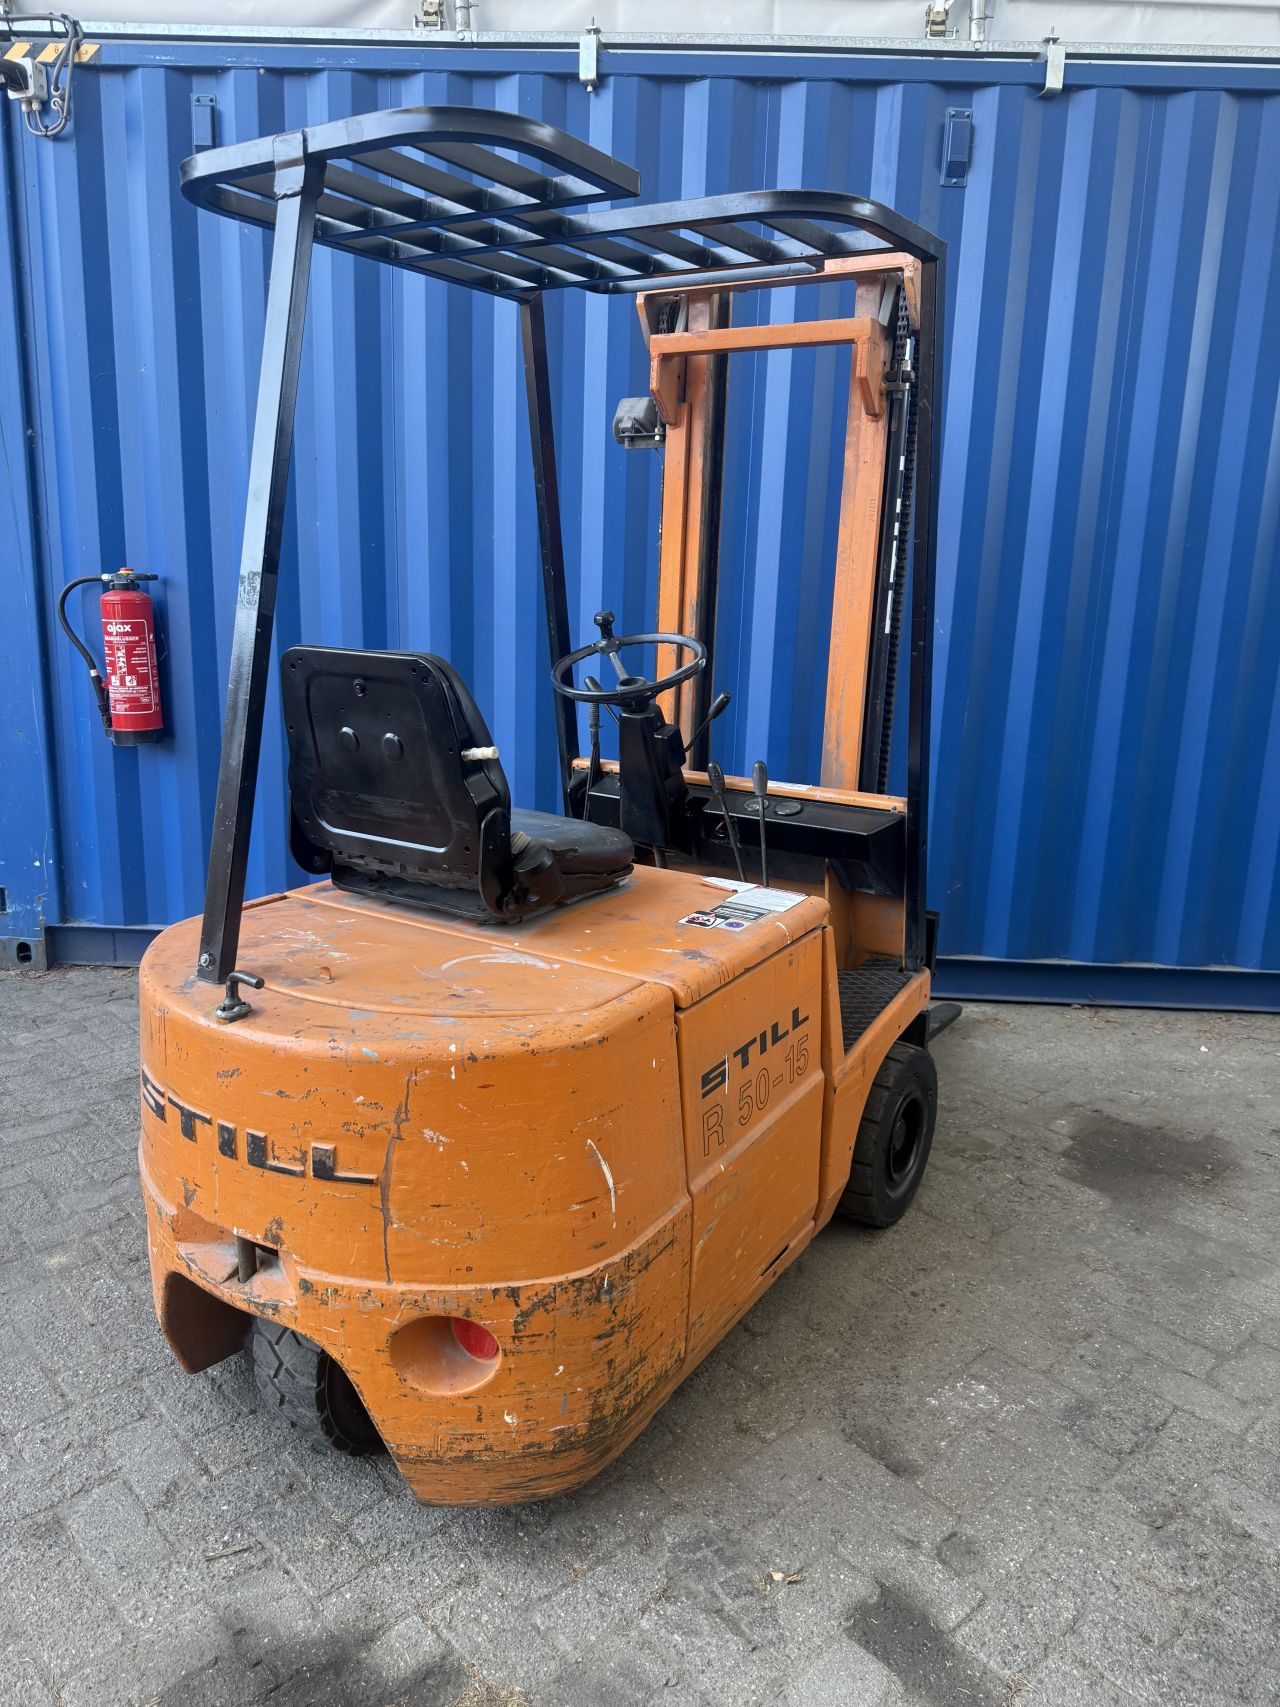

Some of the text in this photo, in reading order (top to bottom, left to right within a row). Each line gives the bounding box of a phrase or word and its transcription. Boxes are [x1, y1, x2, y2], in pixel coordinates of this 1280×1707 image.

[107, 622, 132, 635] ajax
[701, 1006, 810, 1100] STILL
[702, 1033, 809, 1158] R 50-15
[141, 1066, 379, 1186] STILL
